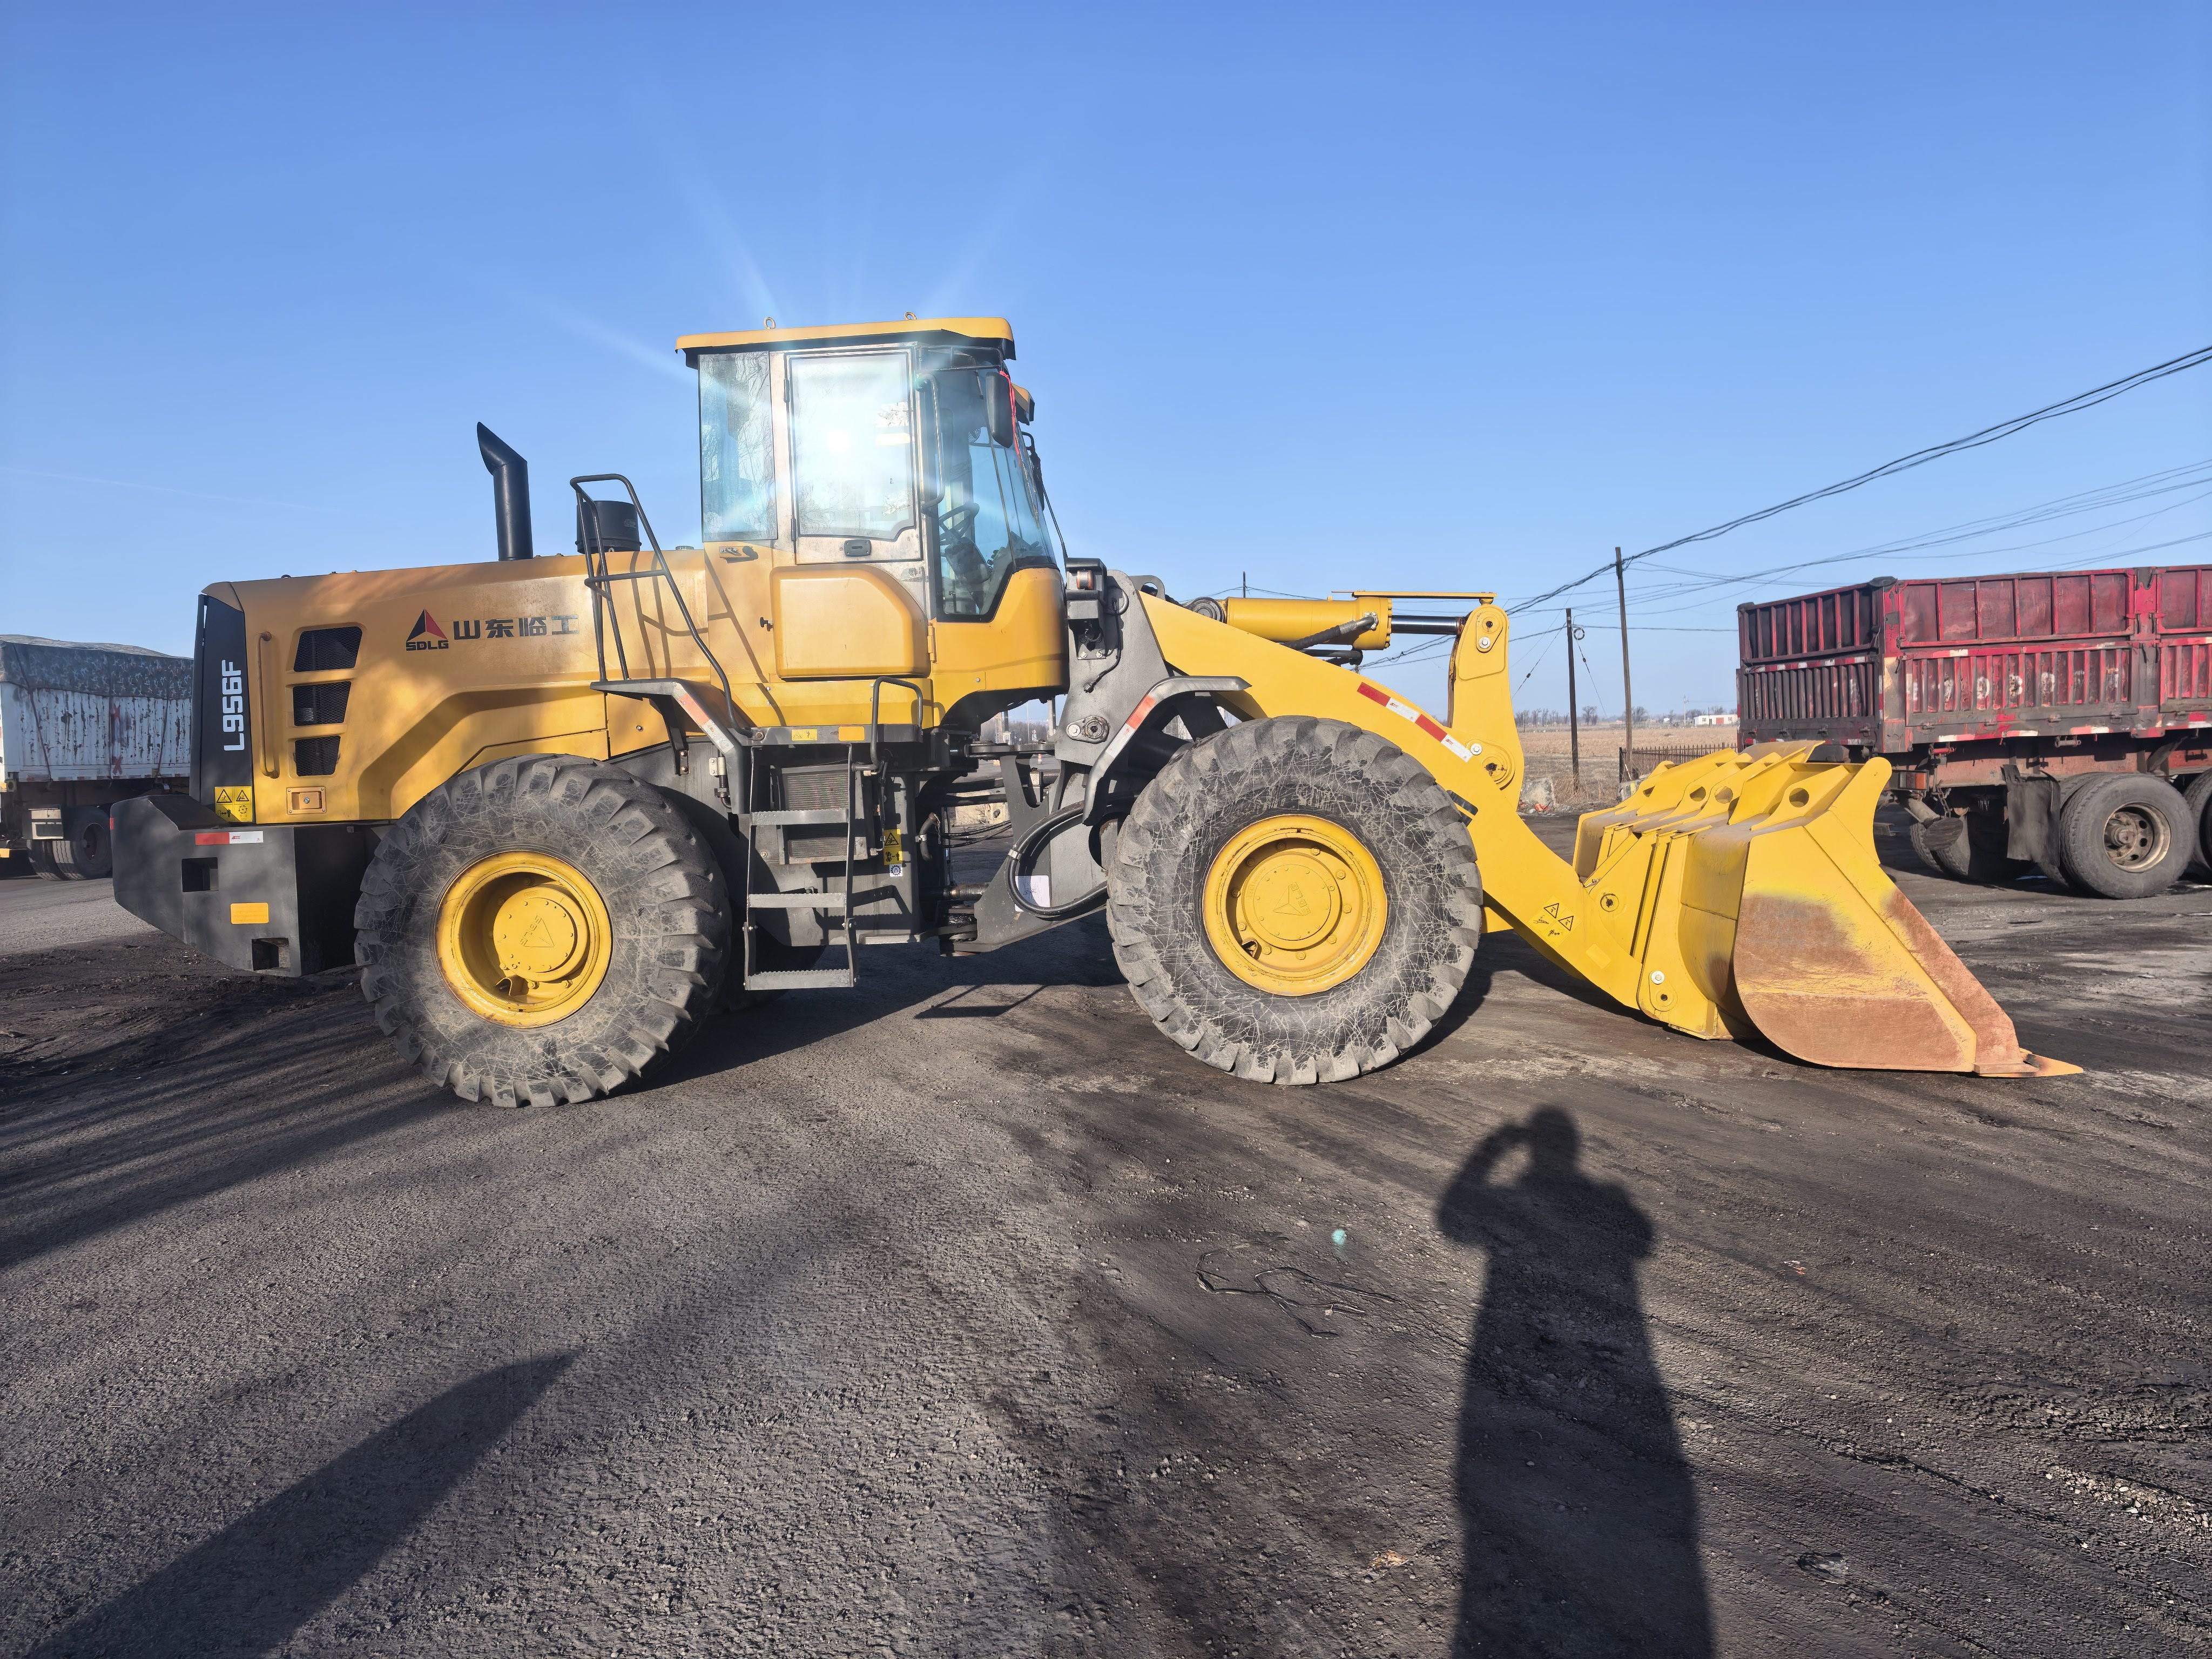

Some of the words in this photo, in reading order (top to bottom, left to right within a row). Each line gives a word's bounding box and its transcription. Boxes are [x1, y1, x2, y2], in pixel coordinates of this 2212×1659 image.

[453, 615, 579, 640] 山东临工
[406, 639, 449, 651] SDLG
[221, 659, 245, 751] L956F
